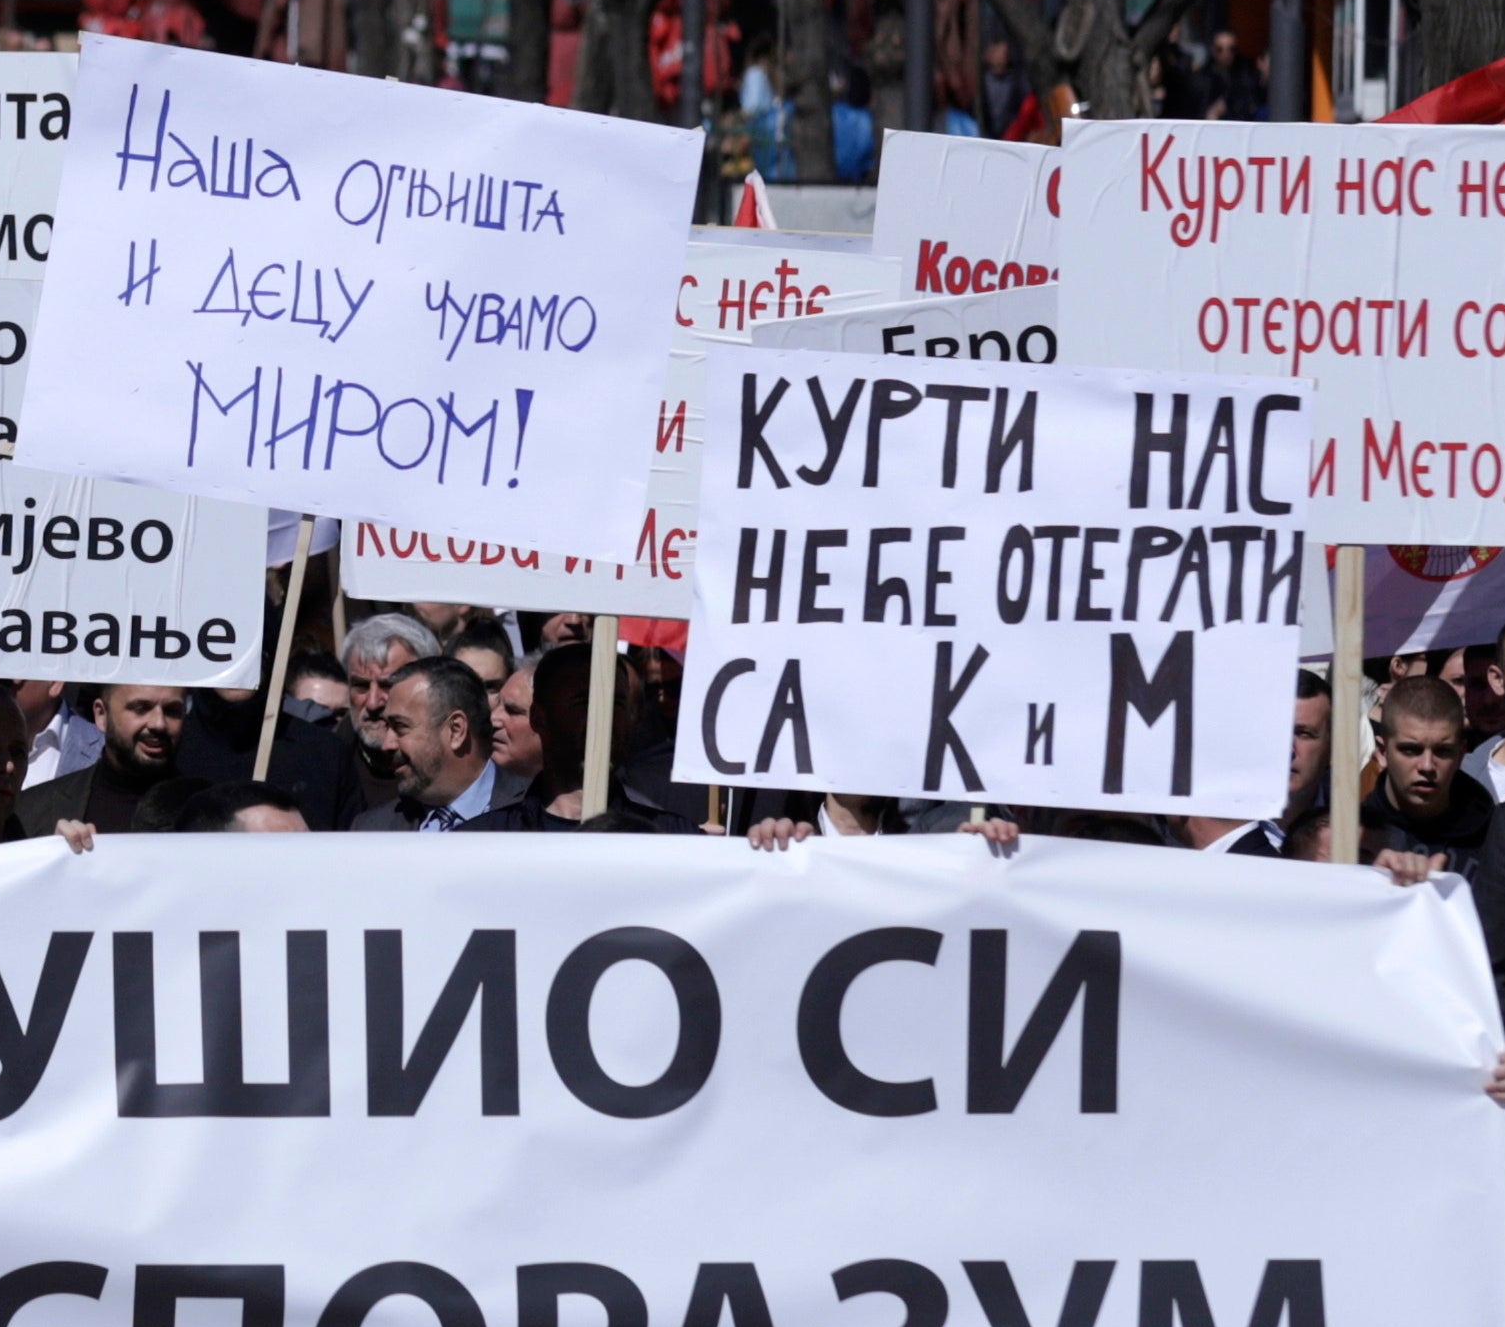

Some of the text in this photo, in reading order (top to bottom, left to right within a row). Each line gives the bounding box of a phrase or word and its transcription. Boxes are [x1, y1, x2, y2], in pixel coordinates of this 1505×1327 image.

[1143, 136, 1310, 247] Курти
[1338, 159, 1434, 215] нас
[916, 239, 1058, 295] Косов
[1200, 298, 1427, 375] отерати
[186, 360, 534, 489] МИРОМ!
[738, 374, 1037, 493] КУРТИ
[1130, 393, 1300, 515] НАС
[732, 526, 960, 627] НЕЋЕ
[998, 525, 1304, 629] ОТЕРАТИ
[702, 658, 812, 774] СА
[924, 642, 989, 791] К
[1103, 631, 1193, 796] М
[797, 927, 1121, 1117] СИ
